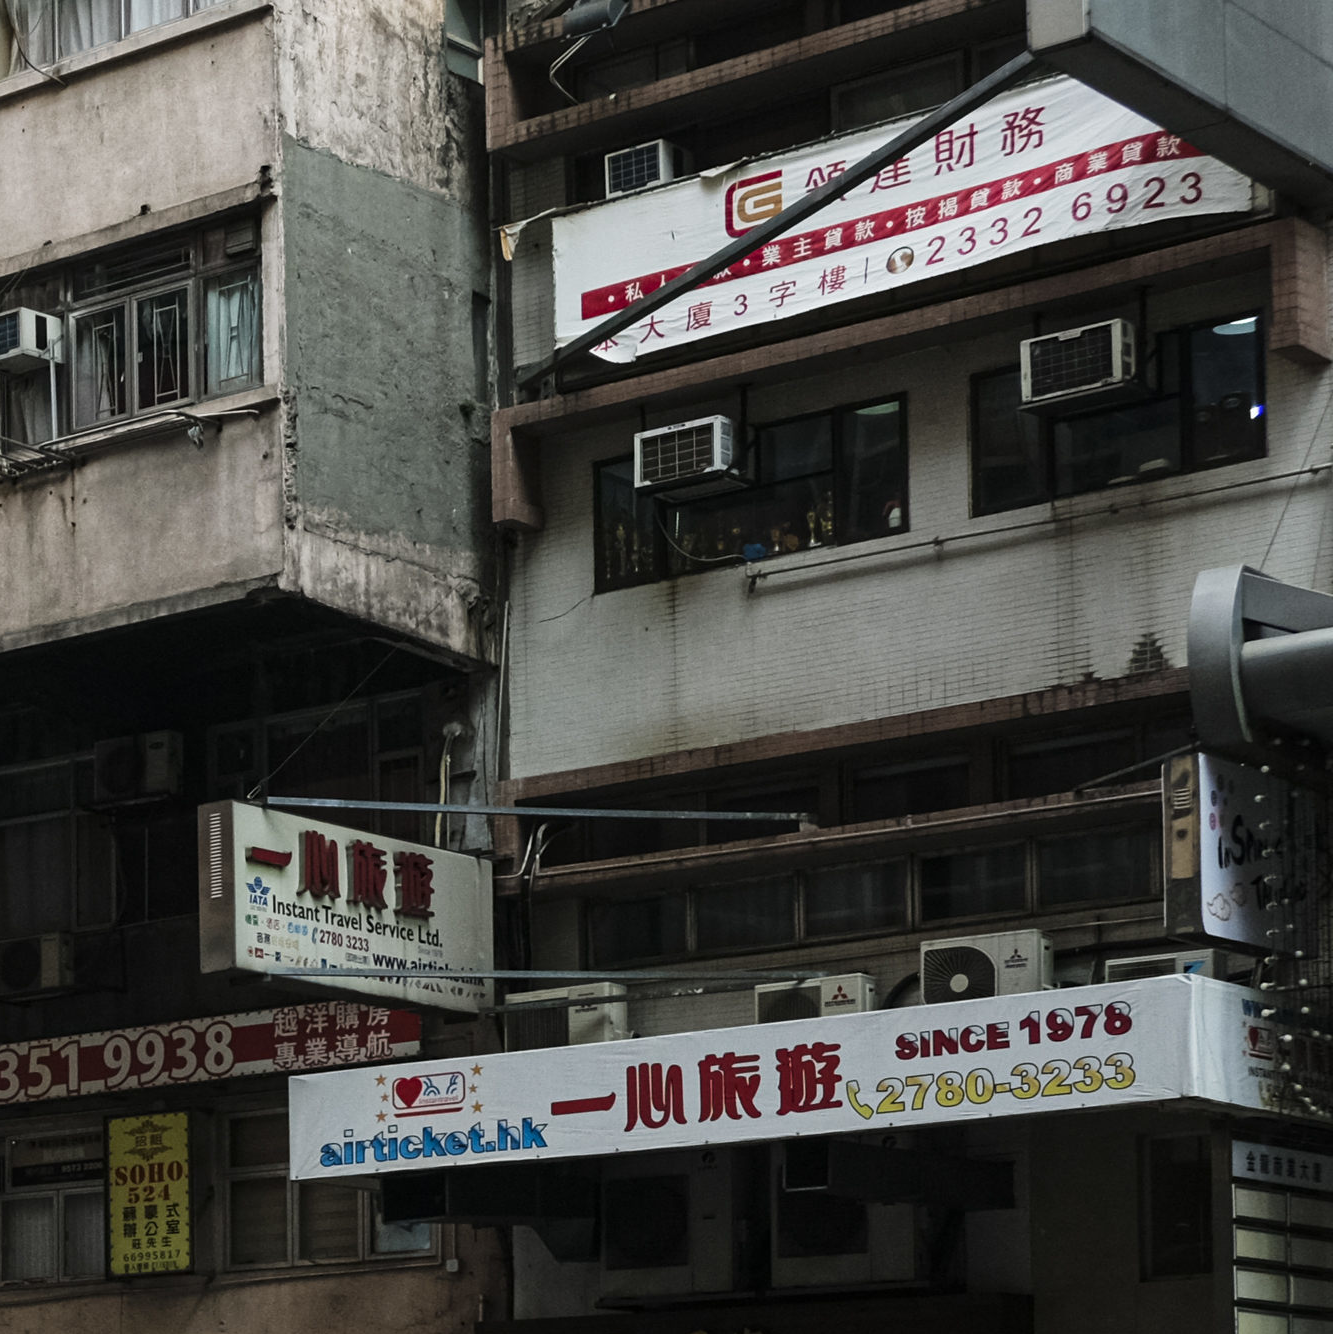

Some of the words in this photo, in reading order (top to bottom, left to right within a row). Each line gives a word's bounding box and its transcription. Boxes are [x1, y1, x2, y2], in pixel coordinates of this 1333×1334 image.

[926, 206, 1042, 266] 2332
[1071, 171, 1202, 222] 6923
[249, 893, 268, 907] IATA
[272, 895, 320, 924] Instant
[322, 905, 362, 931] Travel
[366, 916, 414, 942] Service
[418, 926, 443, 948] Ltd.
[319, 930, 343, 947] 2780
[346, 935, 370, 952] 3233
[104, 1022, 232, 1087] 9938
[273, 1031, 391, 1067] 專業導航
[894, 1020, 1011, 1061] SINCE
[1019, 1001, 1133, 1046] 1978
[550, 1042, 842, 1132] 一心旅遊
[876, 1052, 1137, 1116] 2780-3233
[319, 1117, 548, 1167] airticket.hk
[115, 1161, 183, 1187] SOHO
[128, 1184, 170, 1204] 524
[123, 1250, 181, 1262] 66995817
